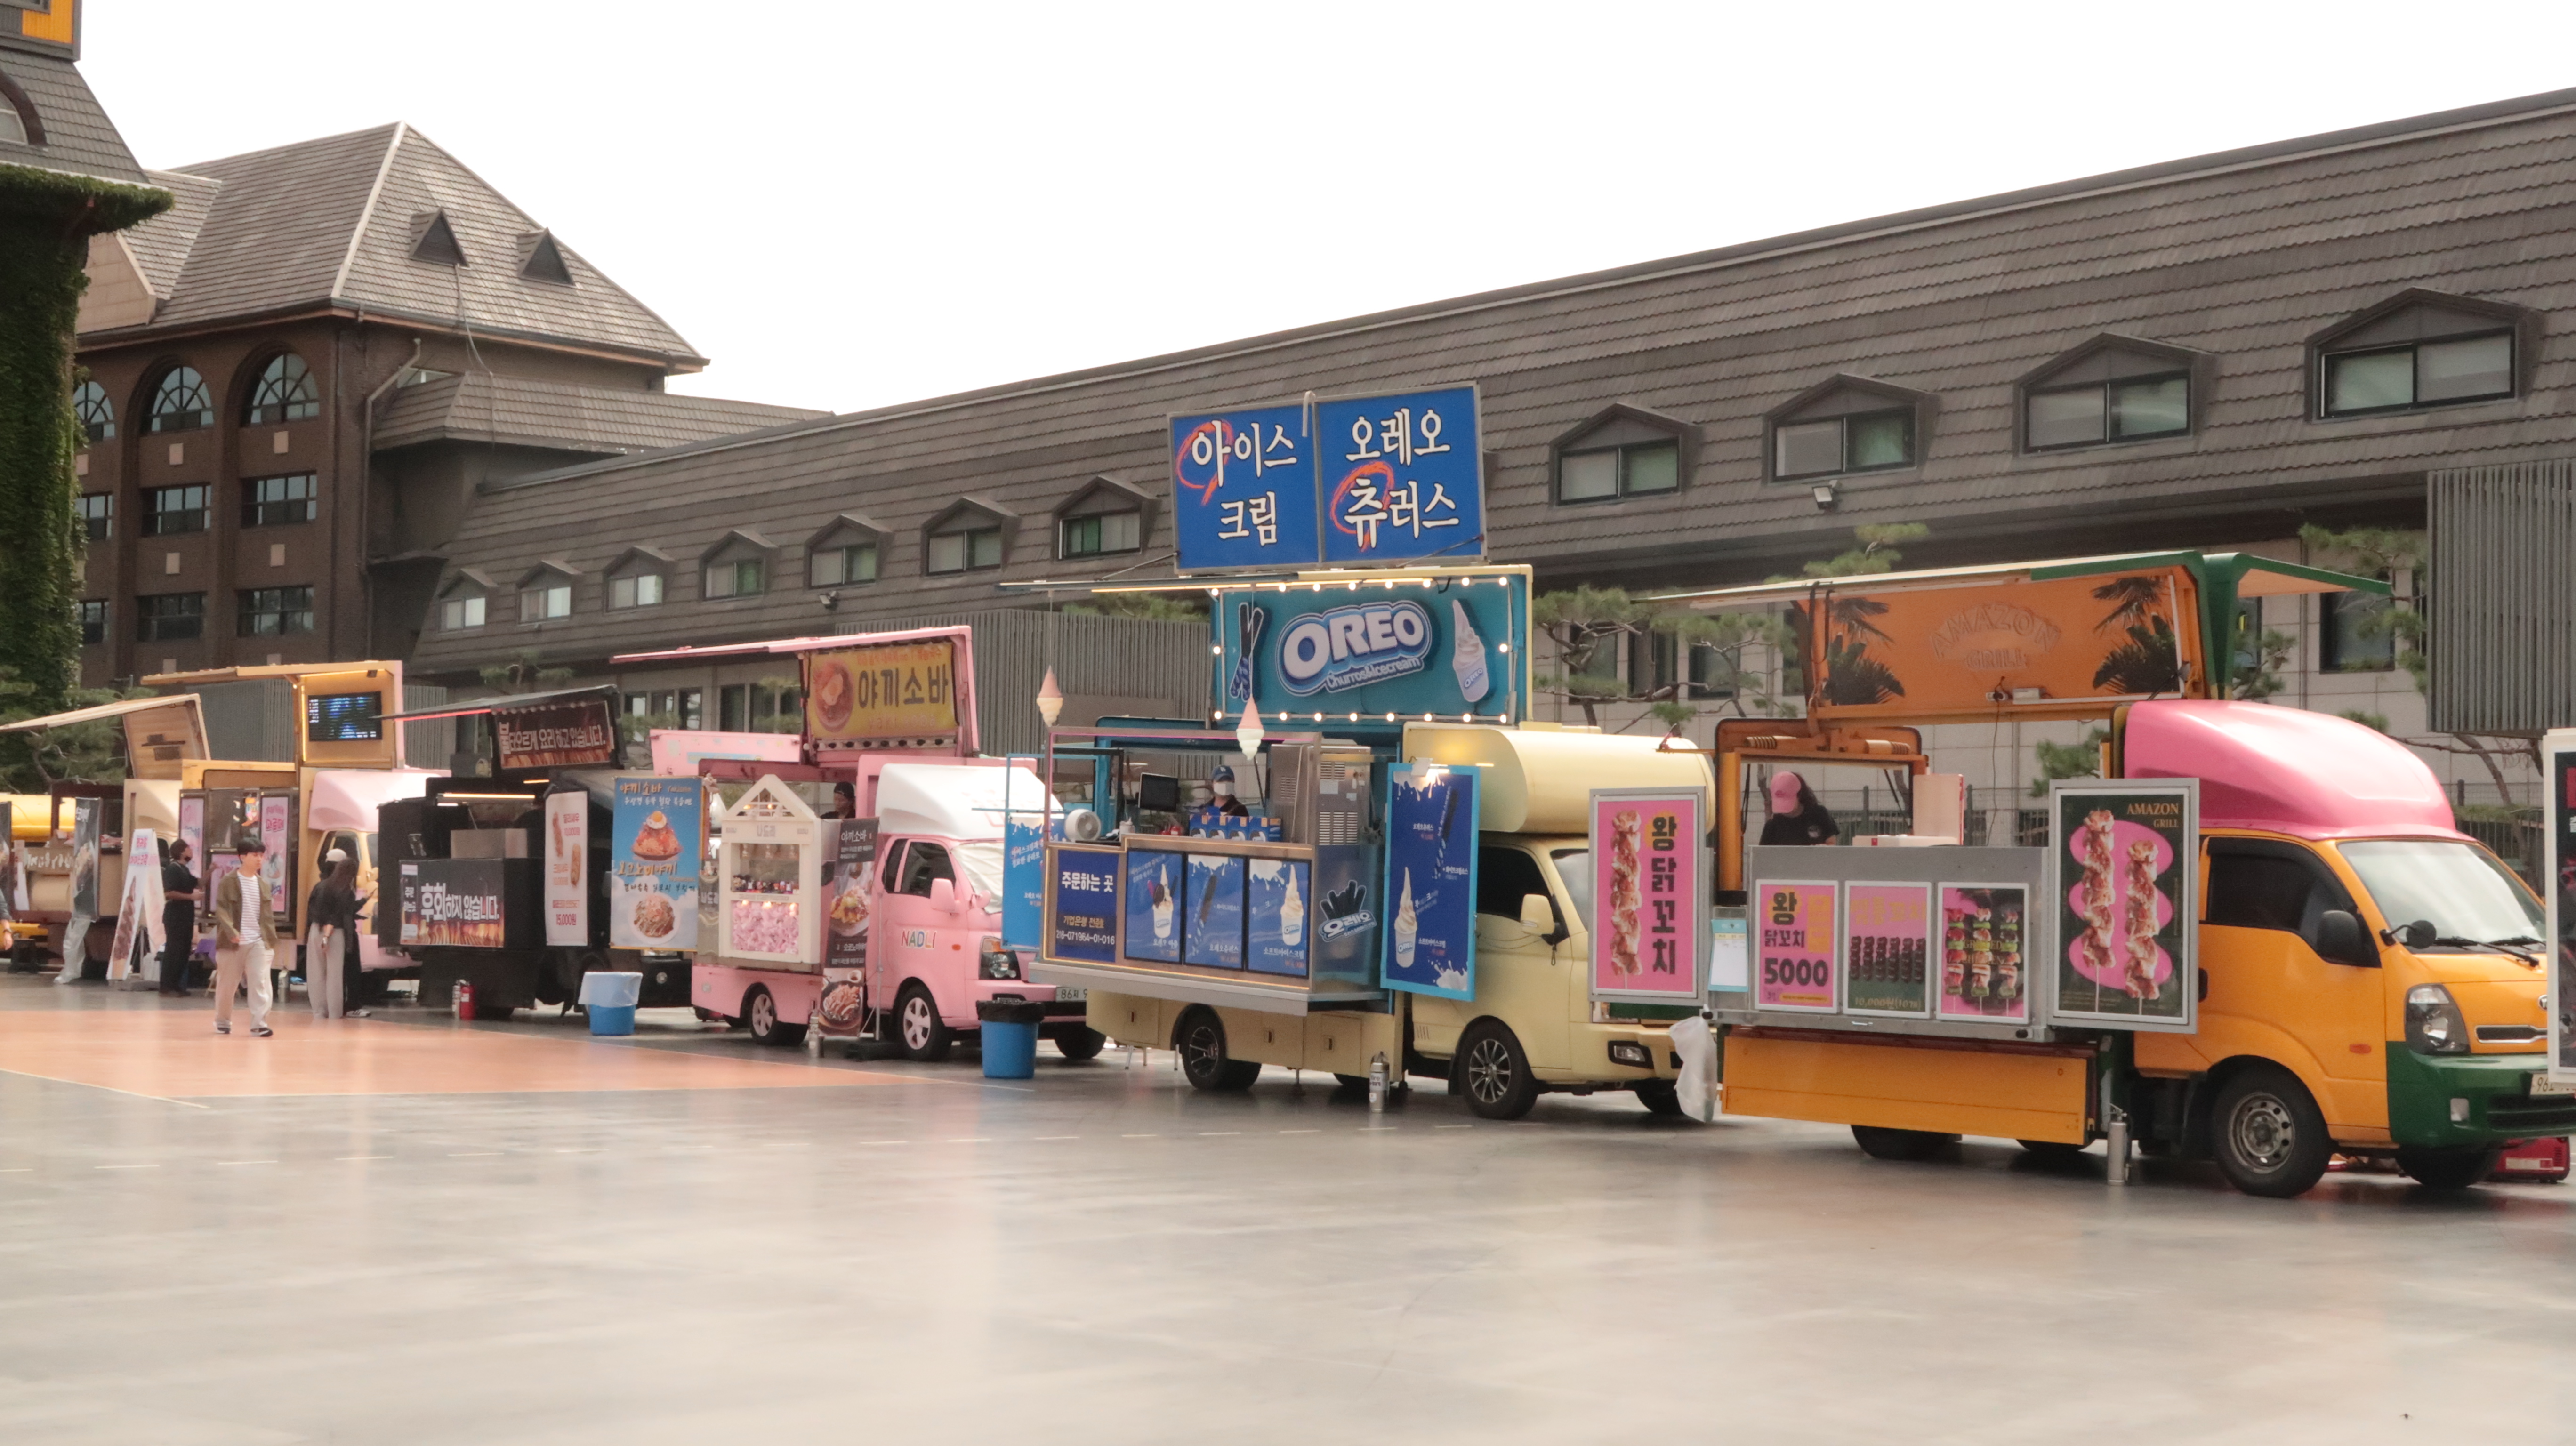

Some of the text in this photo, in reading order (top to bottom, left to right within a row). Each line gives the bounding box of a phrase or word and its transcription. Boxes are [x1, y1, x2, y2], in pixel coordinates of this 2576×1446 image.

[1345, 408, 1451, 466] 오레오
[1191, 420, 1297, 488] 아이스
[1217, 491, 1278, 546] 크림
[1344, 477, 1460, 549] 츄러스
[1284, 609, 1424, 679] OREO
[1930, 603, 2061, 662] AMAZON
[1965, 648, 2027, 670] GRILL
[858, 664, 949, 709] 야끼소바
[1464, 667, 1484, 688] OREO
[539, 728, 571, 749] 요리하고
[2127, 803, 2179, 816] AMAZON
[2153, 819, 2179, 828] GRILL
[841, 829, 867, 843] 야끼소바
[1061, 871, 1114, 893] 주문하는 곳
[420, 882, 462, 923] 후회하지
[1772, 892, 1798, 925] 왕
[901, 929, 937, 949] NADLI
[1323, 912, 1372, 938] 오레오
[1763, 929, 1805, 948] 닭꼬치
[1764, 957, 1829, 988] 5000
